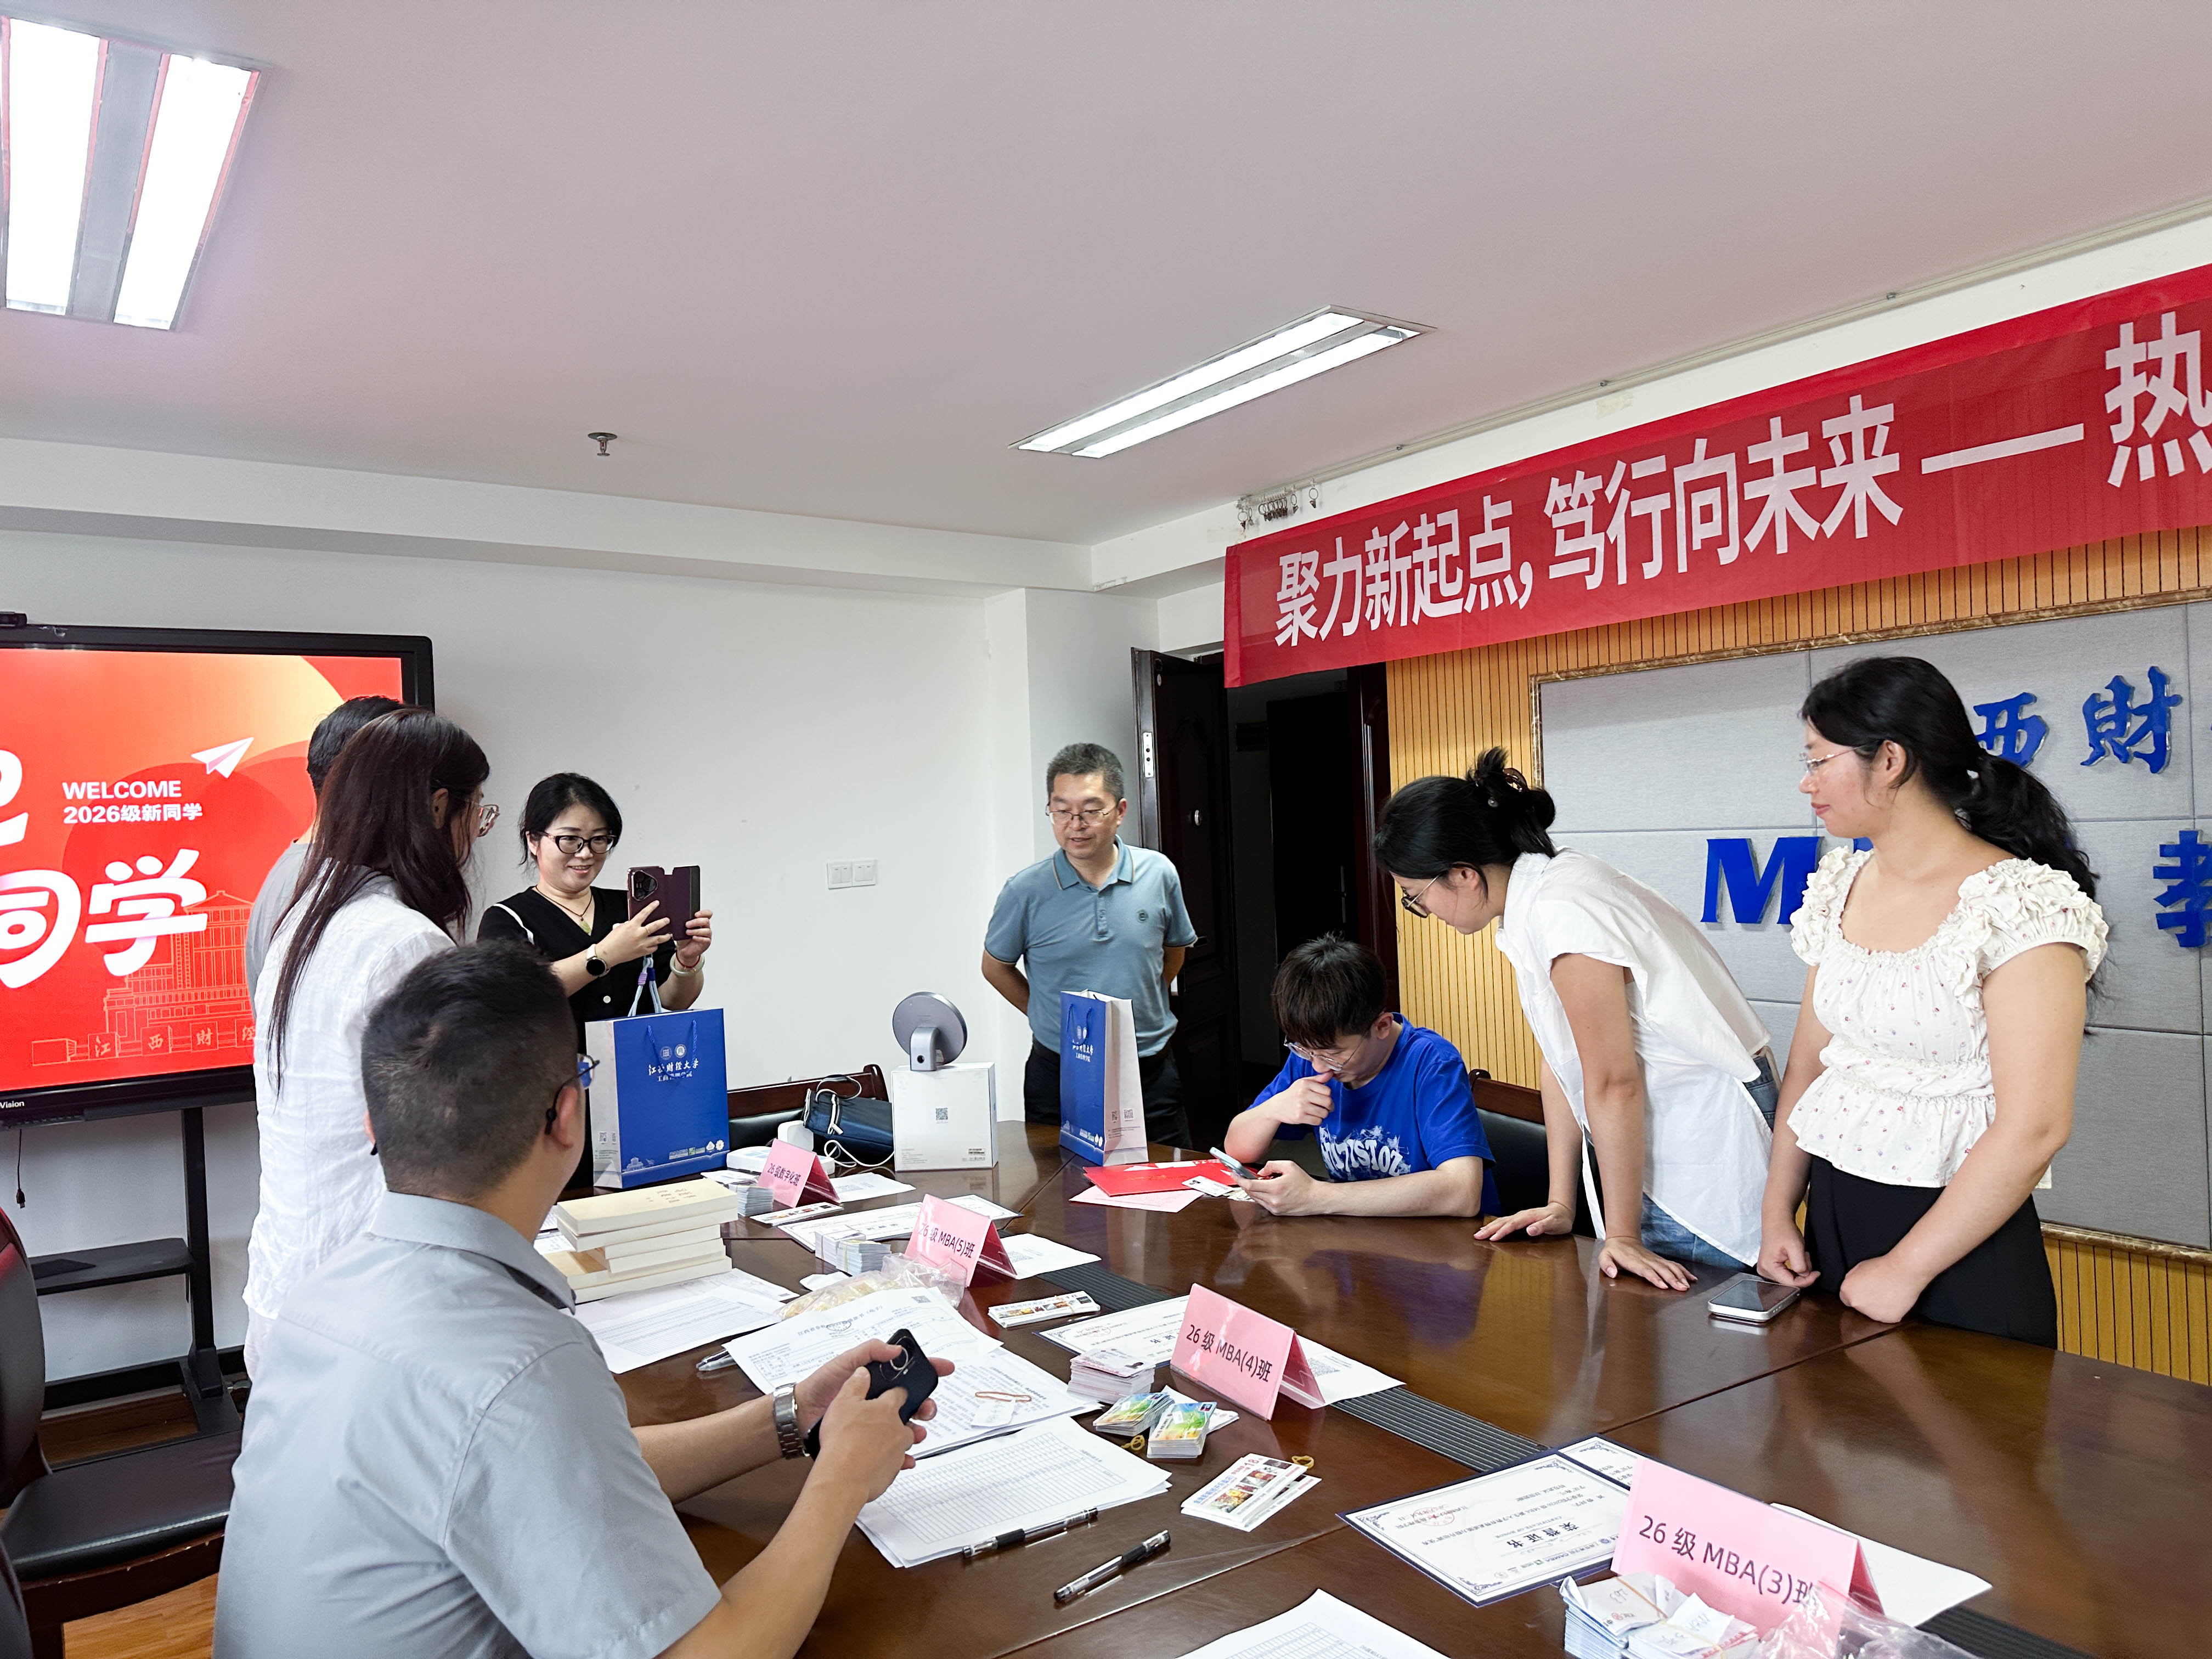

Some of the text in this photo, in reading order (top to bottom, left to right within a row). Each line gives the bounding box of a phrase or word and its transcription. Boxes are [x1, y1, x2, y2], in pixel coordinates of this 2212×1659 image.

[62, 780, 182, 799] WELCOME
[63, 803, 203, 824] 2026级新同学
[767, 1163, 776, 1174] 26
[918, 1222, 975, 1259] 26 级 MBA(5)班
[1186, 1324, 1201, 1344] 26
[1201, 1330, 1215, 1353] 级
[1216, 1339, 1273, 1383] MBA(4)班
[1506, 1522, 1579, 1548] 荣誉证书
[1639, 1515, 1667, 1544] 26
[1671, 1527, 1696, 1560] 级
